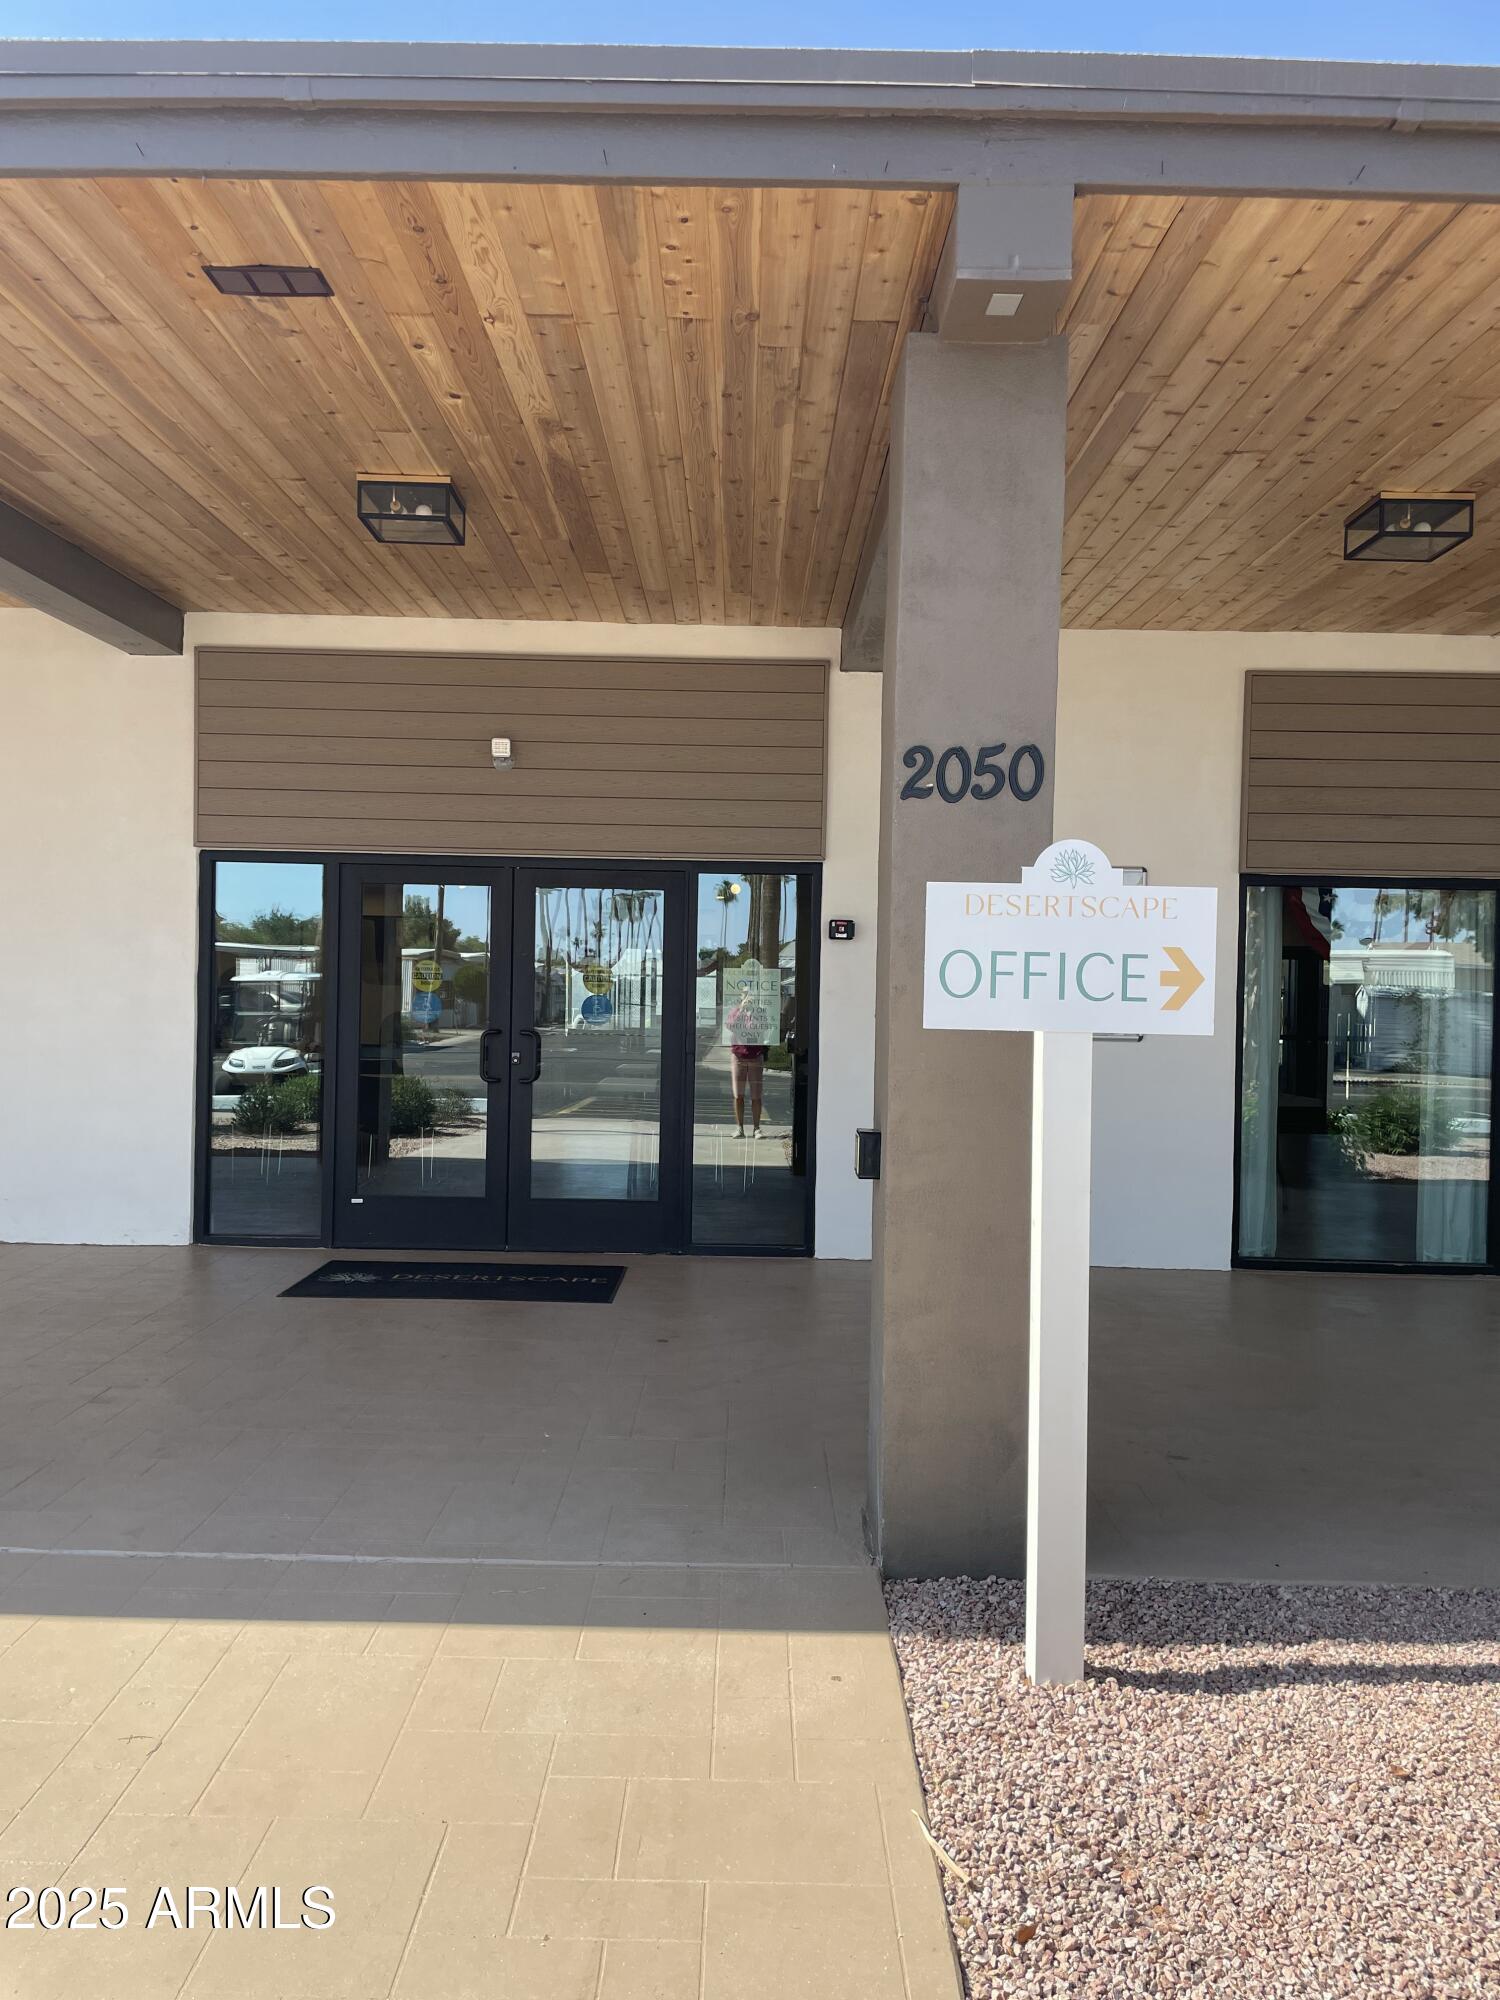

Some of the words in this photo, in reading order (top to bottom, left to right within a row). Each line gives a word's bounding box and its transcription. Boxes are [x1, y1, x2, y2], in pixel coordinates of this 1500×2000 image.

[900, 742, 1045, 804] 2050
[965, 893, 1178, 920] DESERTSCAPE
[726, 980, 778, 991] NOTICE
[939, 949, 1149, 1002] OFFICE
[391, 1273, 609, 1285] DESERTSCAPE
